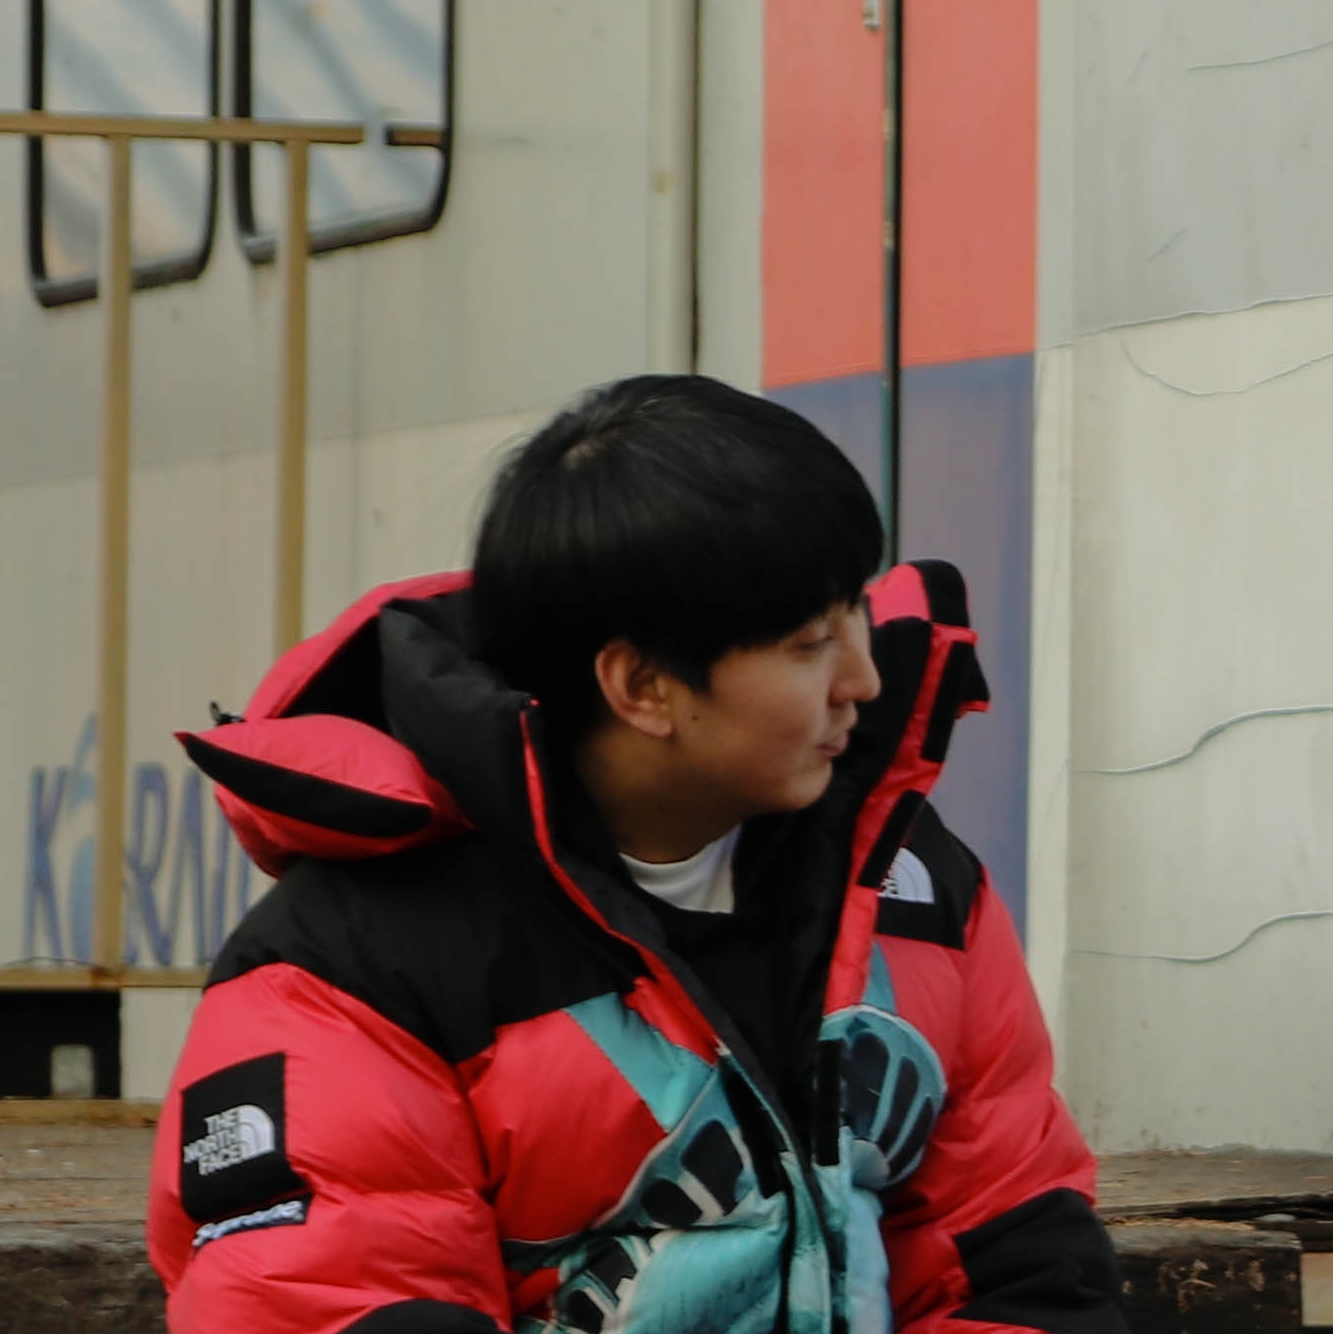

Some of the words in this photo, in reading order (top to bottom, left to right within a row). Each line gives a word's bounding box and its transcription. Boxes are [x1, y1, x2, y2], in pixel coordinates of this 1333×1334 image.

[205, 1108, 240, 1134] THE
[183, 1129, 238, 1163] NORTH
[199, 1142, 244, 1175] FACE
